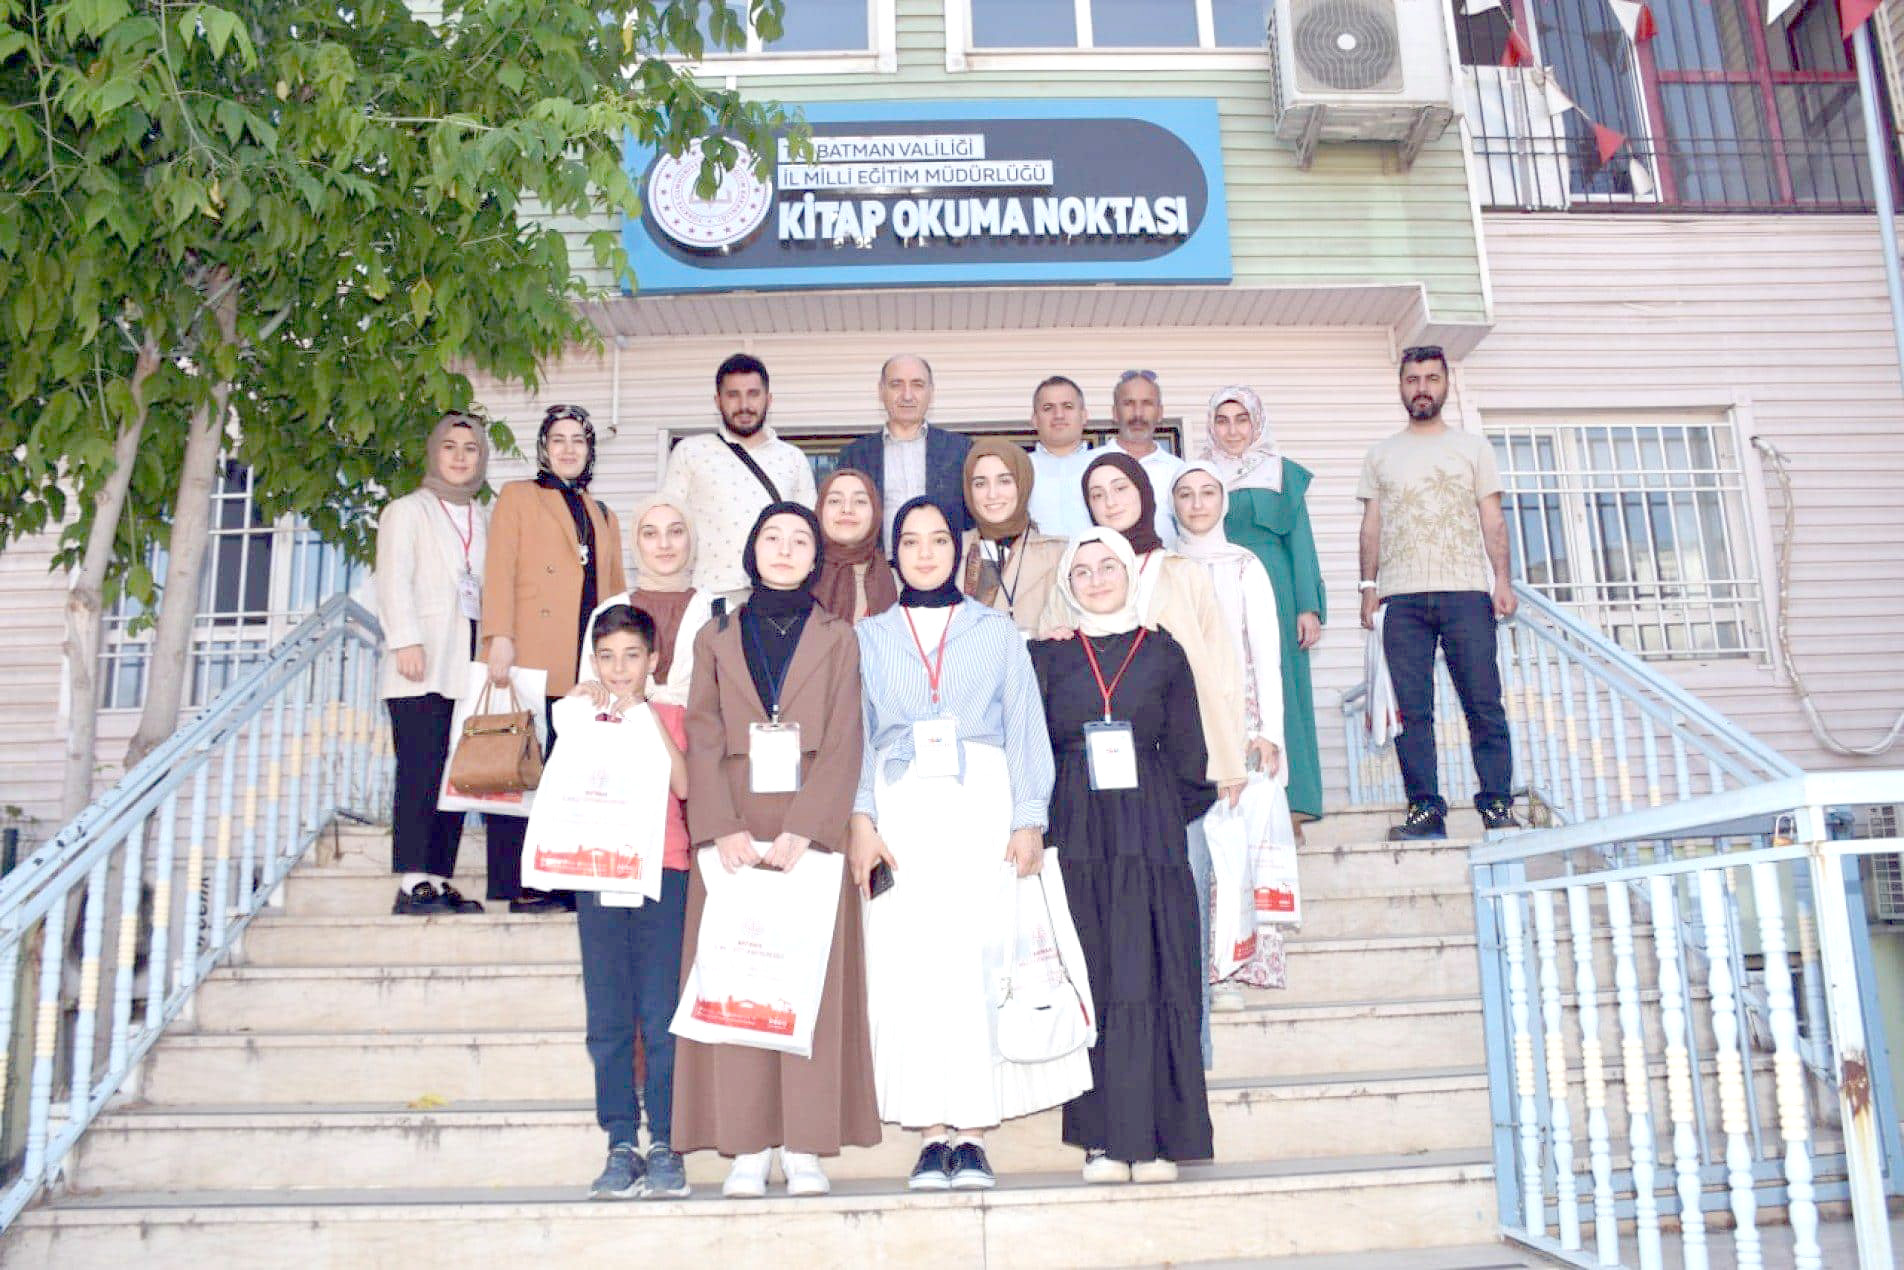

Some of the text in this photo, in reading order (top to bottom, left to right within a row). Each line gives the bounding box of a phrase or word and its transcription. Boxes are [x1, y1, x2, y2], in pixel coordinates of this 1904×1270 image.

[817, 143, 895, 158] BATMAN
[898, 138, 973, 157] VALİLİĞİ
[784, 164, 1045, 186] İL MİLLİ EĞİTİM MÜDÜRLÜĞÜ
[778, 192, 886, 240] KİTAP
[892, 198, 1030, 237] OKUMA
[1032, 196, 1189, 236] NOKTASI
